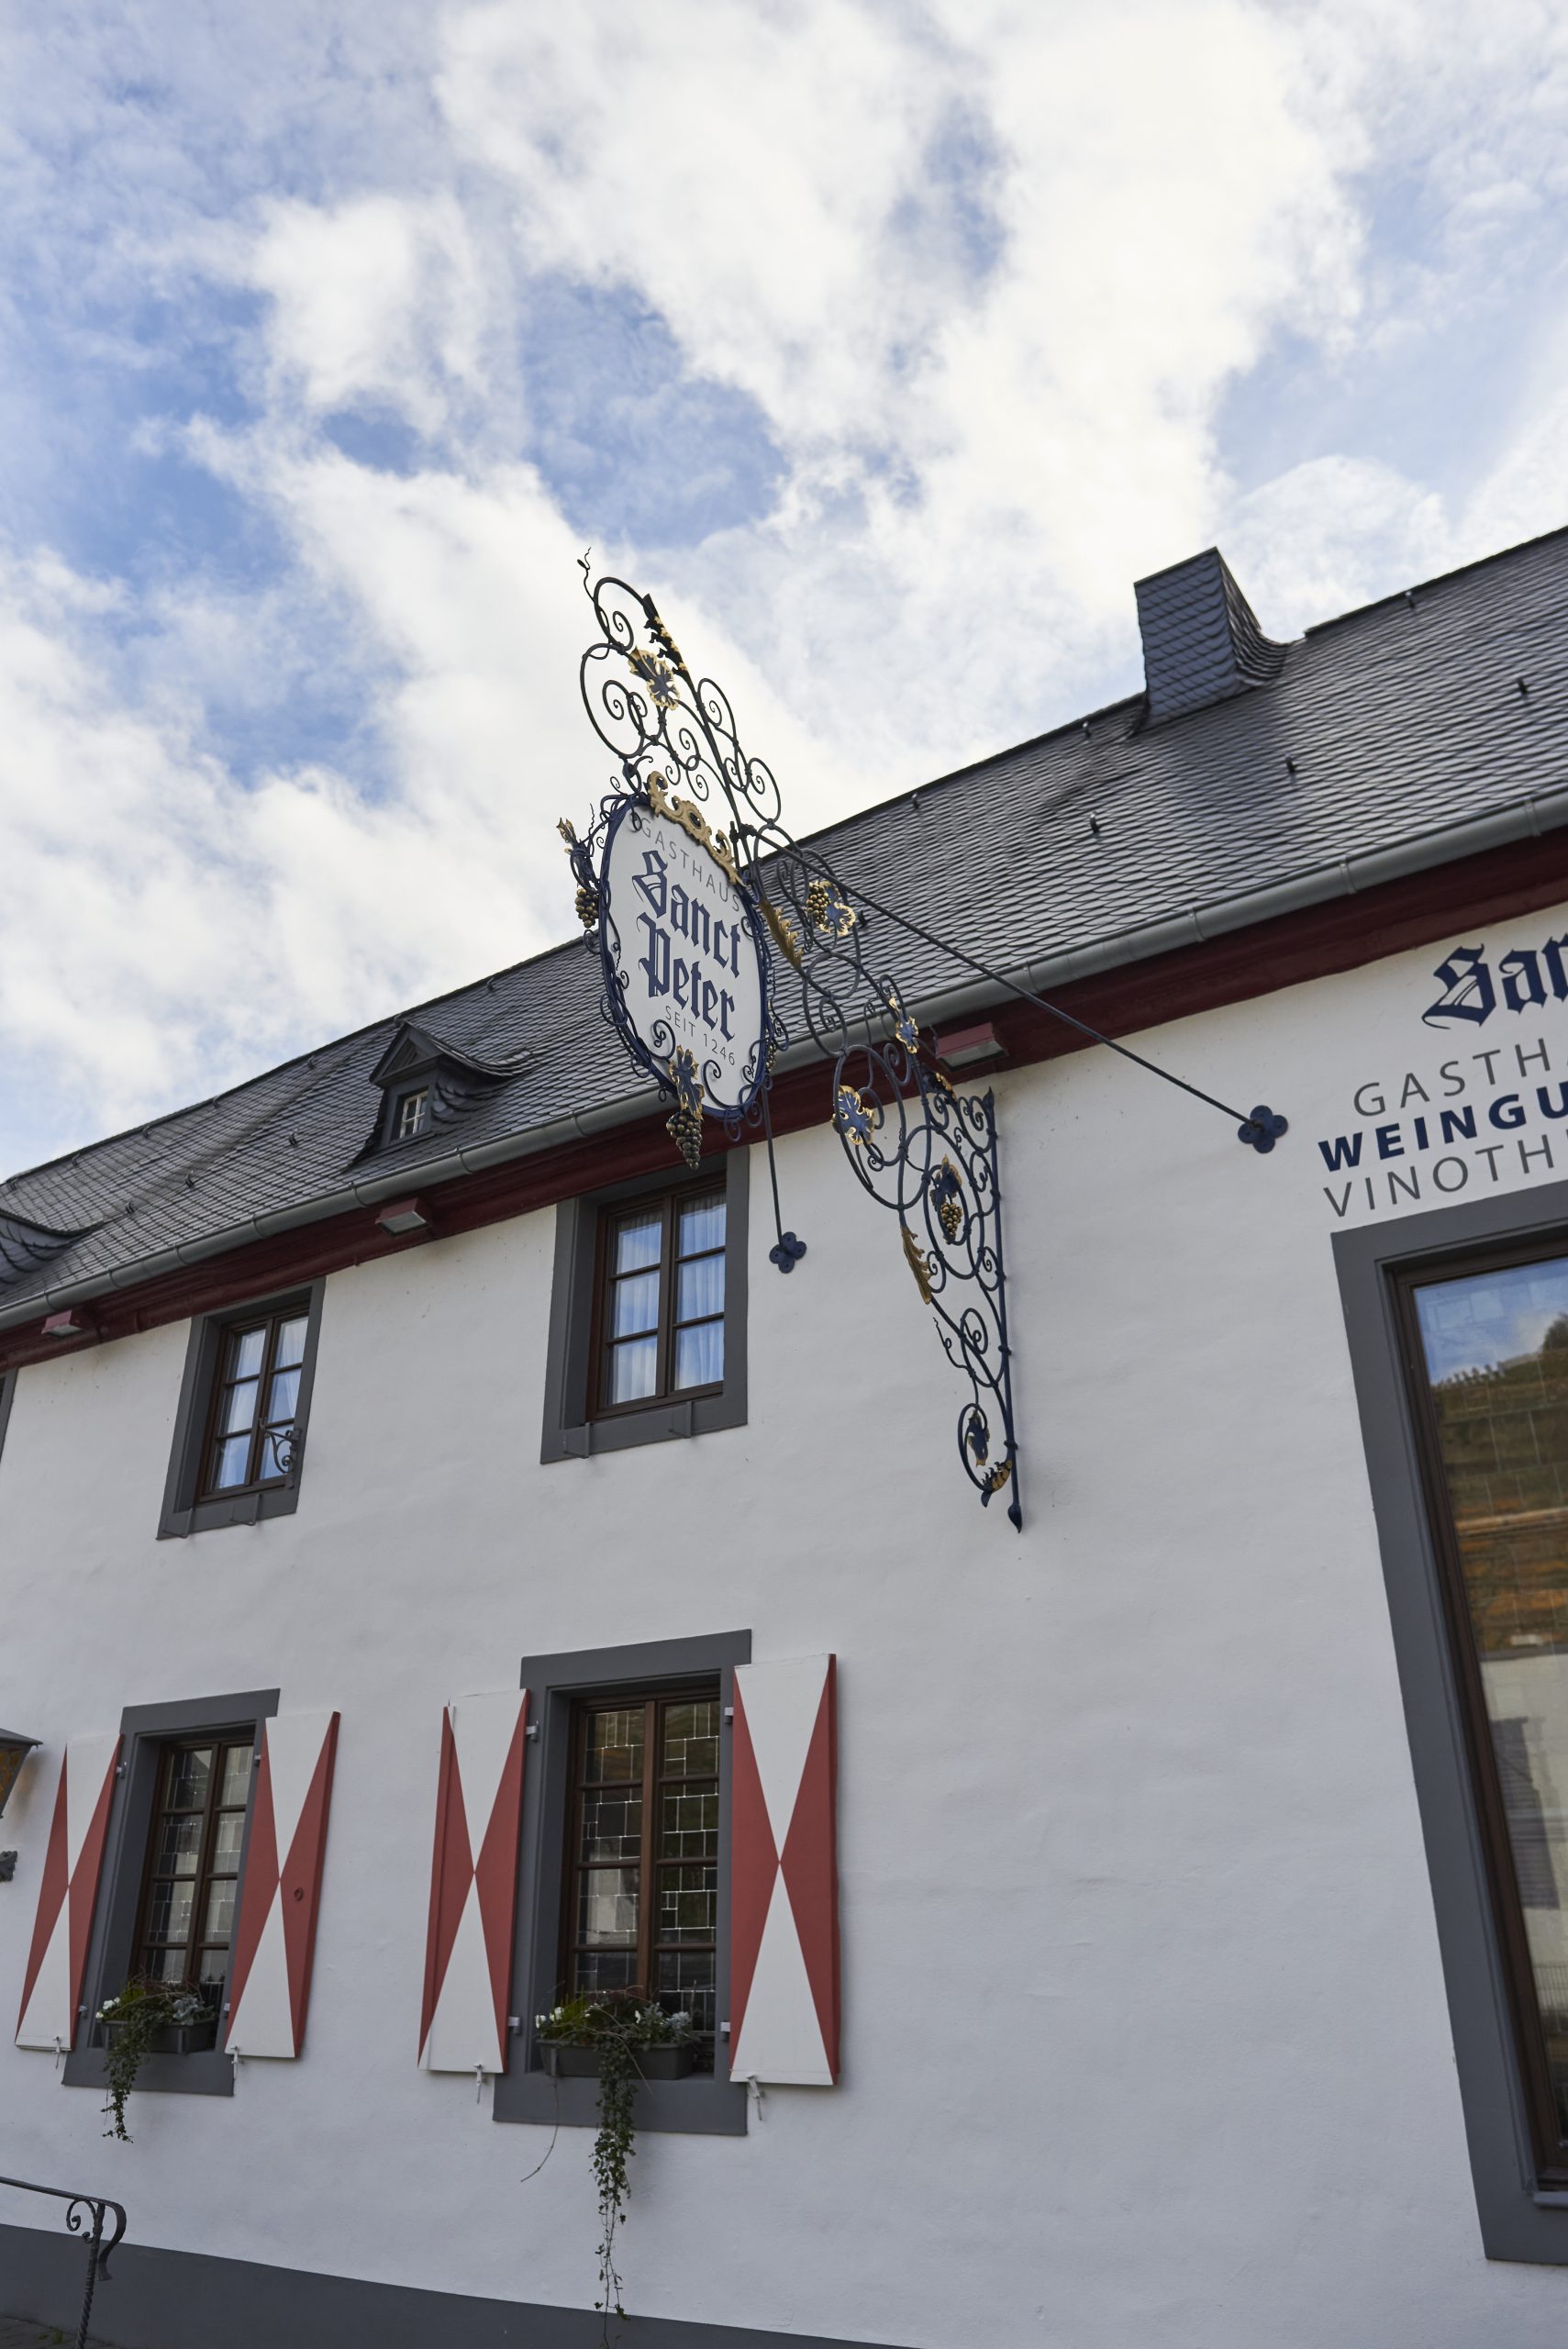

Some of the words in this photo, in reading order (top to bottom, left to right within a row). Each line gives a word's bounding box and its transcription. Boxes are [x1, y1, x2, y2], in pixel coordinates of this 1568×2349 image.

[641, 818, 740, 912] GASTHAUS
[632, 850, 741, 978] Sanct
[636, 911, 736, 1042] Peter
[665, 1005, 697, 1037] SEIT
[703, 1033, 736, 1066] 1246
[1353, 1038, 1568, 1118] GASTH
[1318, 1081, 1568, 1173] WEINGU
[1323, 1129, 1568, 1218] VINOTH
